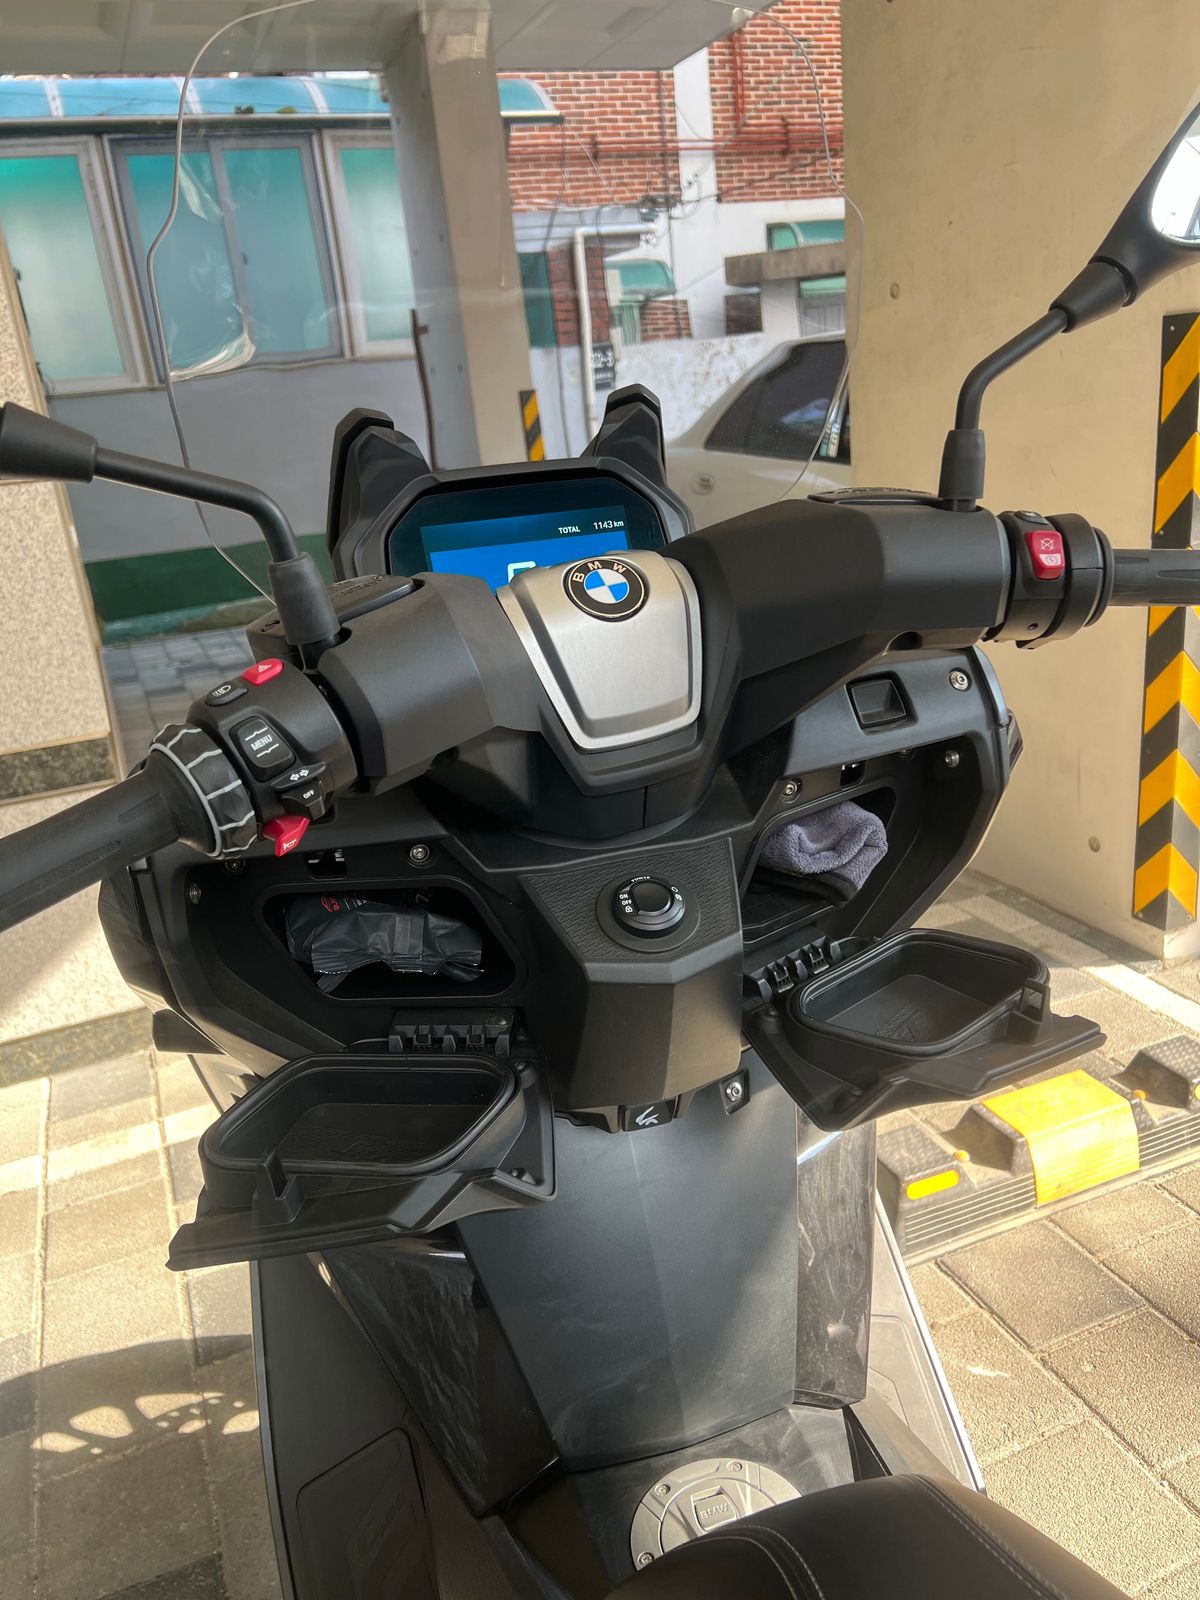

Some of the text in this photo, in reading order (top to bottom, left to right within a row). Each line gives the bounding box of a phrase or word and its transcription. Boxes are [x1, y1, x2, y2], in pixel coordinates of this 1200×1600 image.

[558, 525, 581, 534] TOTAL
[593, 520, 613, 530] 1143
[572, 560, 627, 583] BMW
[250, 734, 273, 751] MENU
[302, 789, 315, 799] OFF
